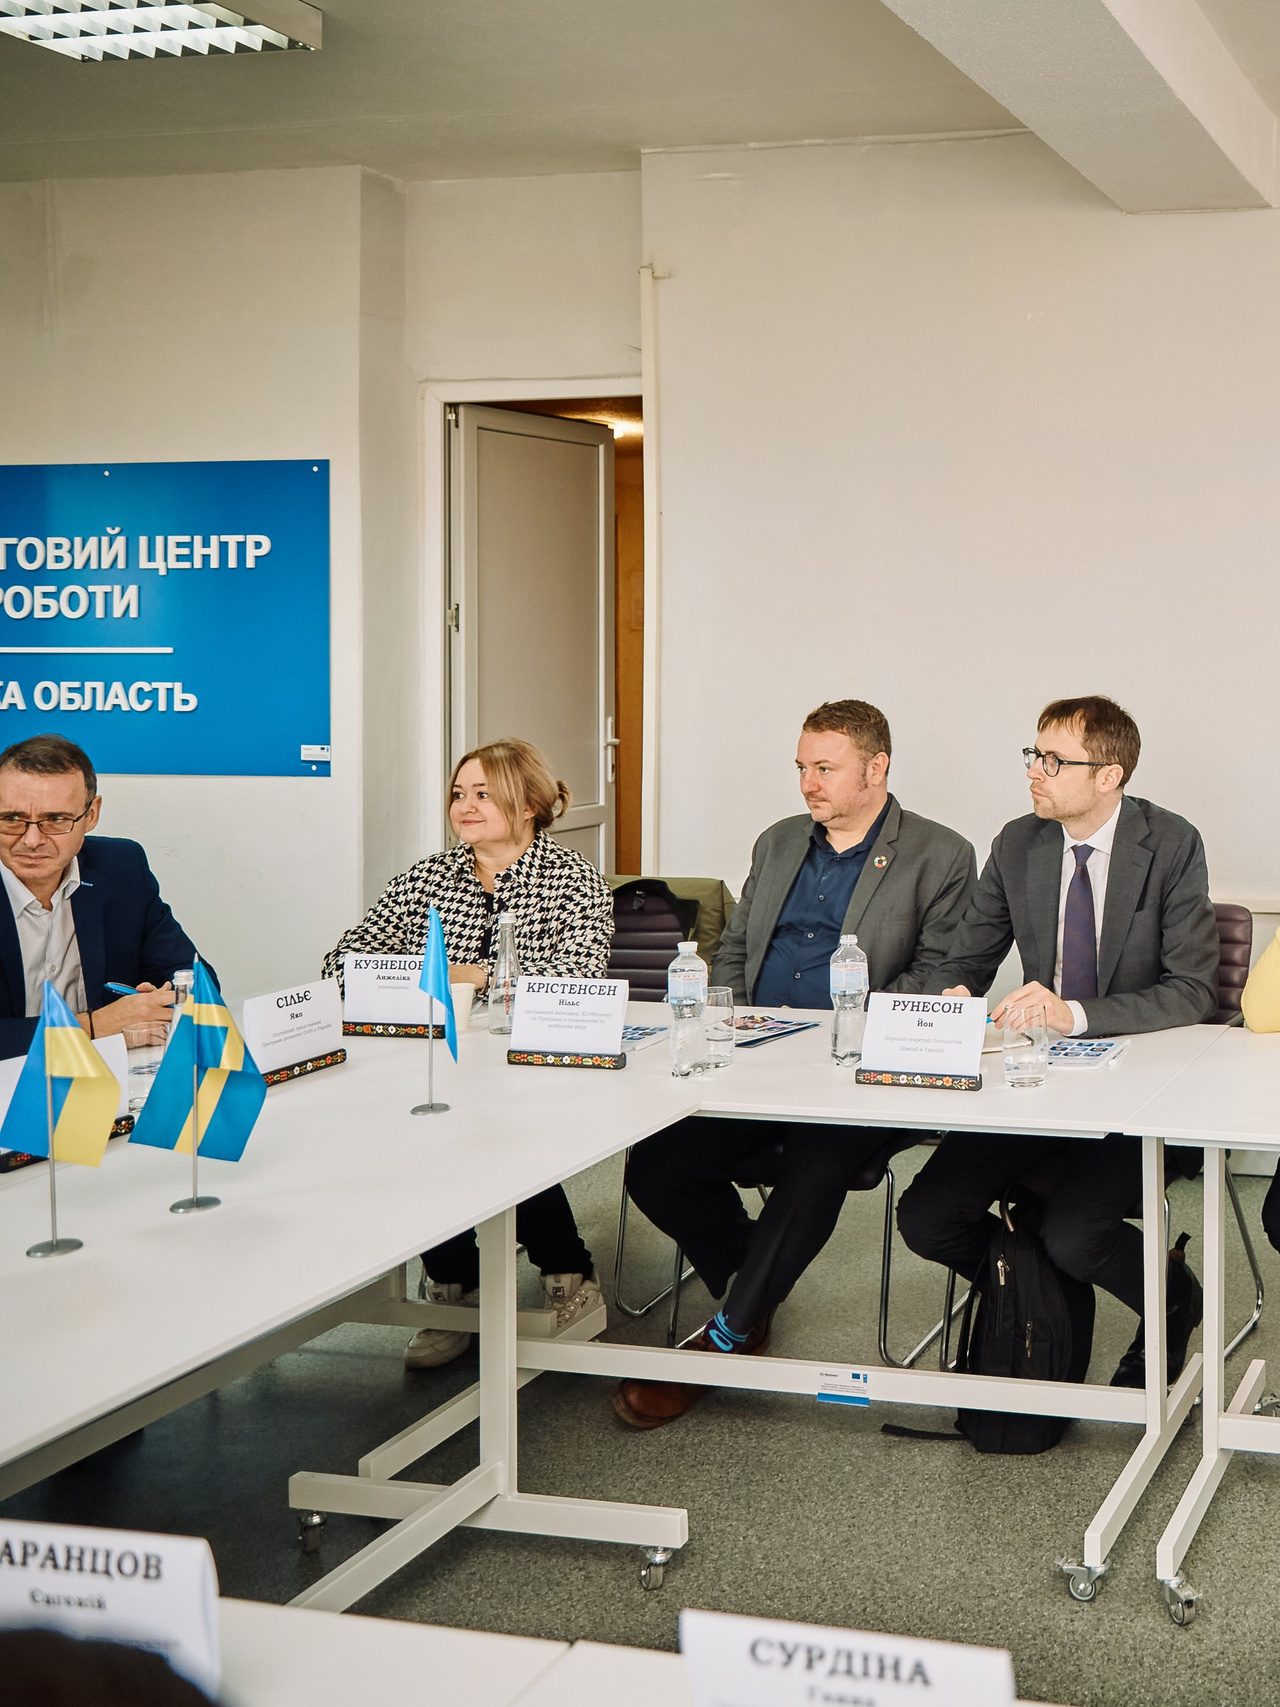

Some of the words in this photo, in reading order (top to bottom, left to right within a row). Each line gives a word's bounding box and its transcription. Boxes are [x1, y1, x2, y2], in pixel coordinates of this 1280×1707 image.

[138, 534, 272, 576] ЦЕНТР
[0, 584, 139, 619] ОБОТИ
[0, 681, 27, 710] А
[33, 680, 199, 712] ОБЛАСТЬ
[526, 982, 618, 996] КРІСТЕНСЕН
[276, 990, 312, 1009] СІЛЬЄ
[892, 1000, 964, 1014] РУНЕСОН
[290, 1012, 303, 1020] Яко
[916, 1017, 934, 1028] Йон
[749, 1637, 931, 1687] СУРДІНА
